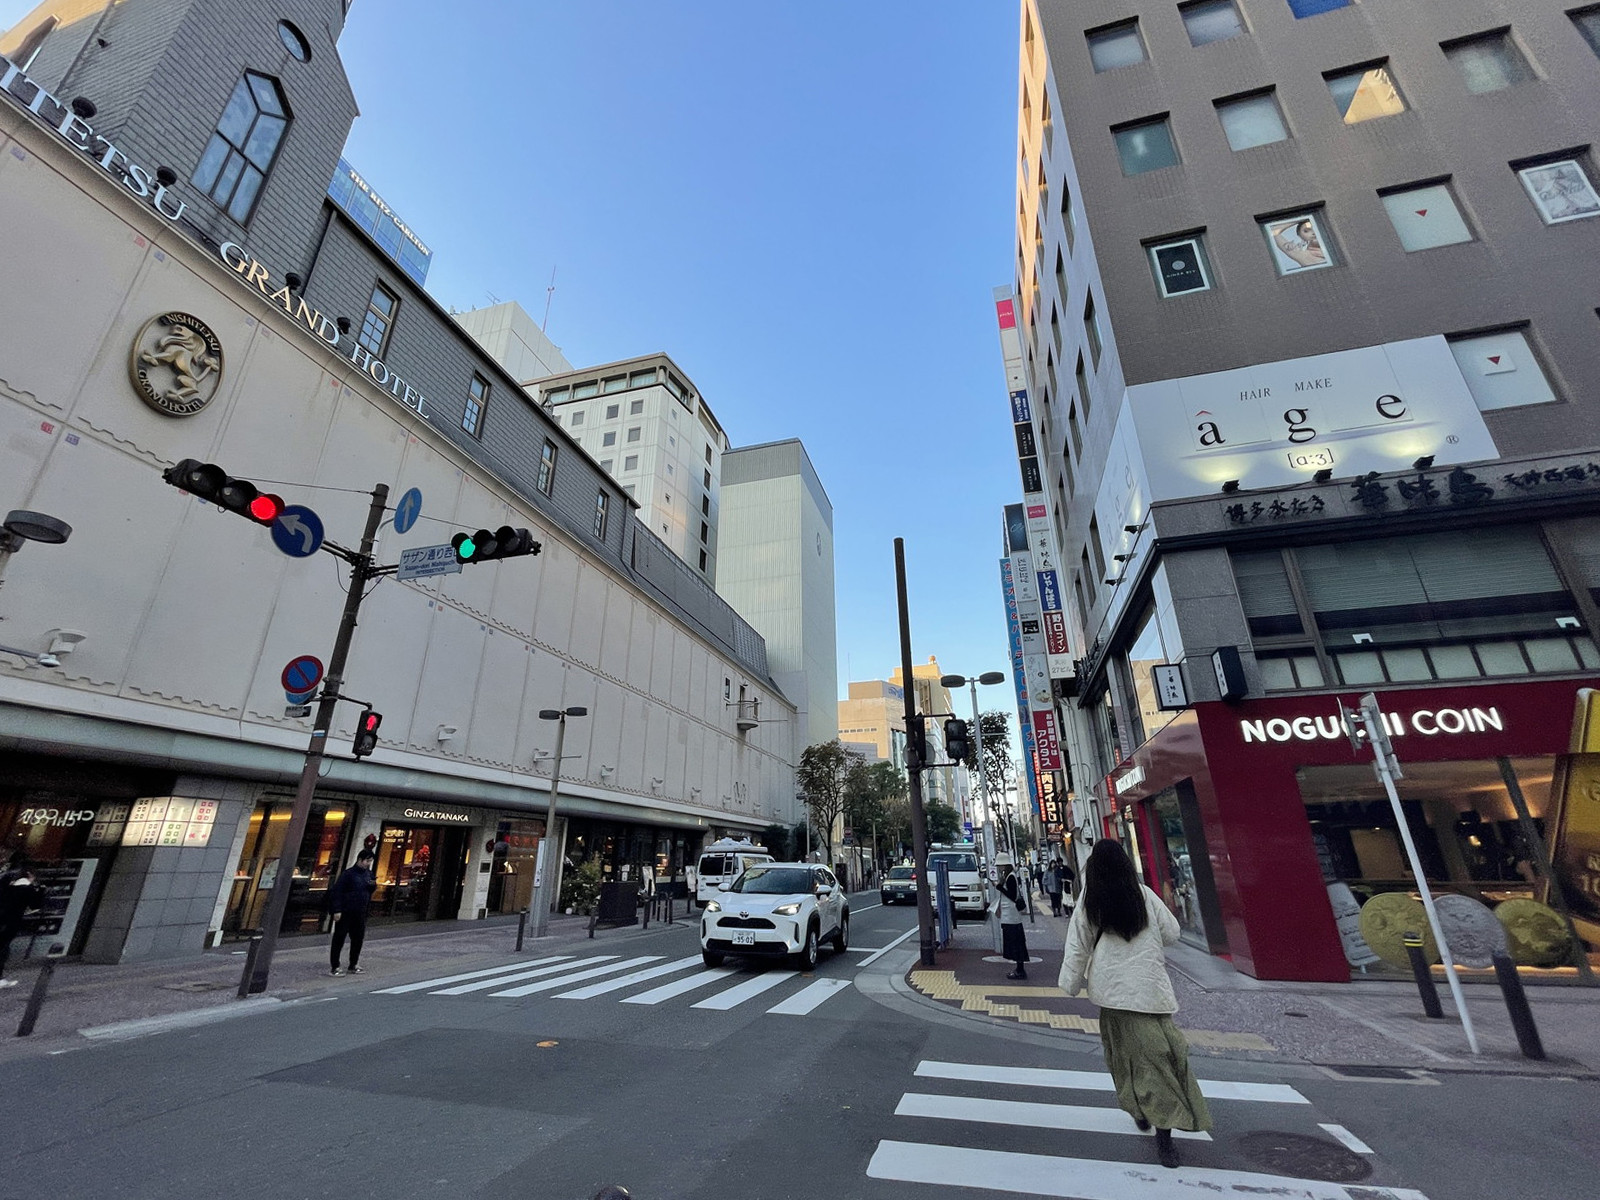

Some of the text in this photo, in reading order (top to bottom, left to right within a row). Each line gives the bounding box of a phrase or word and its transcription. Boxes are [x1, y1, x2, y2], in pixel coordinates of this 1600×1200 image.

[166, 314, 220, 352] NISHITETSU
[219, 241, 341, 345] GRAND
[349, 341, 430, 419] HOTEL
[138, 369, 205, 413] GRAND HOTEL
[1240, 377, 1333, 401] HAIR MAKE
[1052, 613, 1066, 653] 野口コイン
[1411, 707, 1504, 736] COIN
[1037, 729, 1052, 767] アクタス
[404, 808, 469, 822] GINZA TANAKA
